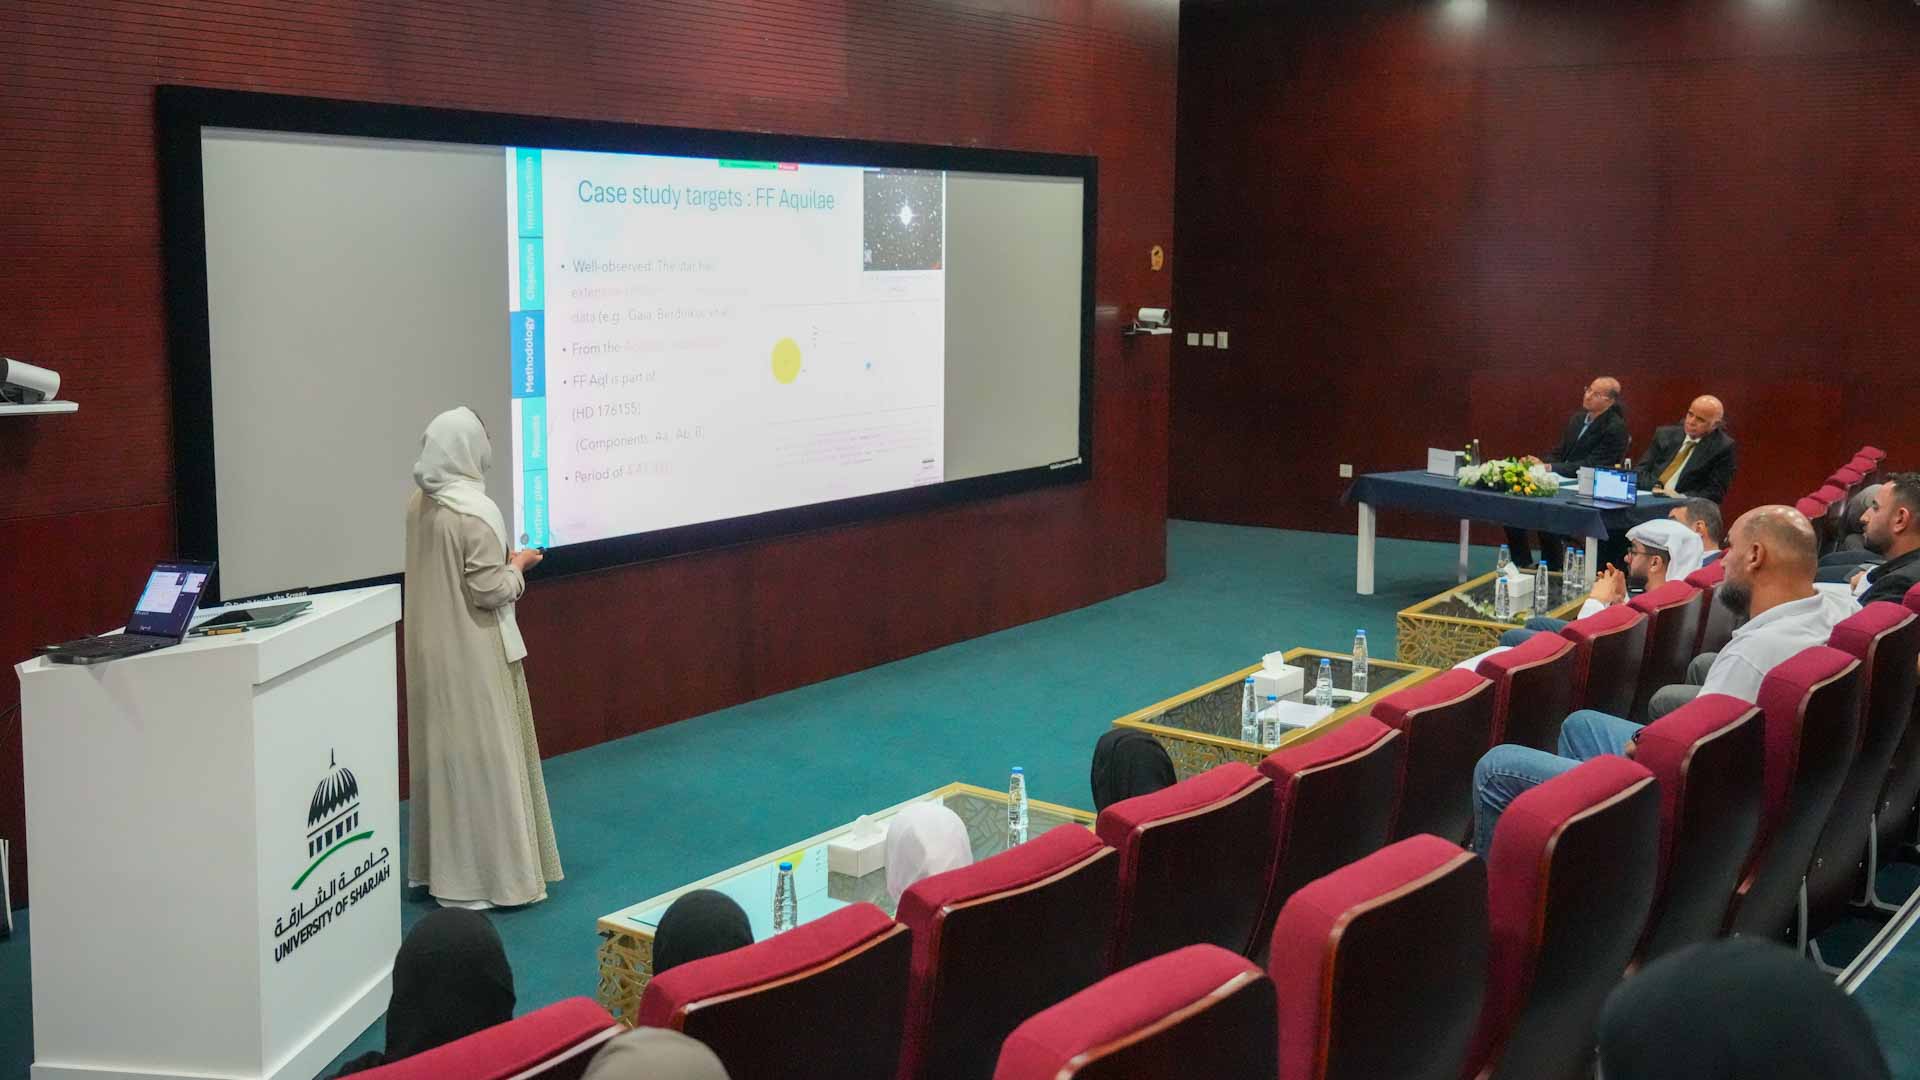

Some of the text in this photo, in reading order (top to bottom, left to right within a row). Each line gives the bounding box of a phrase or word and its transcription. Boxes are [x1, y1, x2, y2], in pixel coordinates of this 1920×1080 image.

[578, 179, 627, 203] Case
[632, 184, 681, 209] study
[686, 186, 742, 211] targets
[755, 187, 776, 207] FF
[778, 188, 835, 212] Aquilae
[525, 316, 535, 393] Methodology
[571, 340, 600, 355] From
[602, 338, 620, 353] the
[573, 374, 586, 386] FF
[622, 372, 642, 390] part
[572, 406, 594, 422] (HD
[574, 465, 609, 482] Period
[612, 465, 624, 479] of
[274, 847, 389, 938] جامعة الشارقة
[274, 864, 390, 963] UNIVERSITY OF SHARJAH
